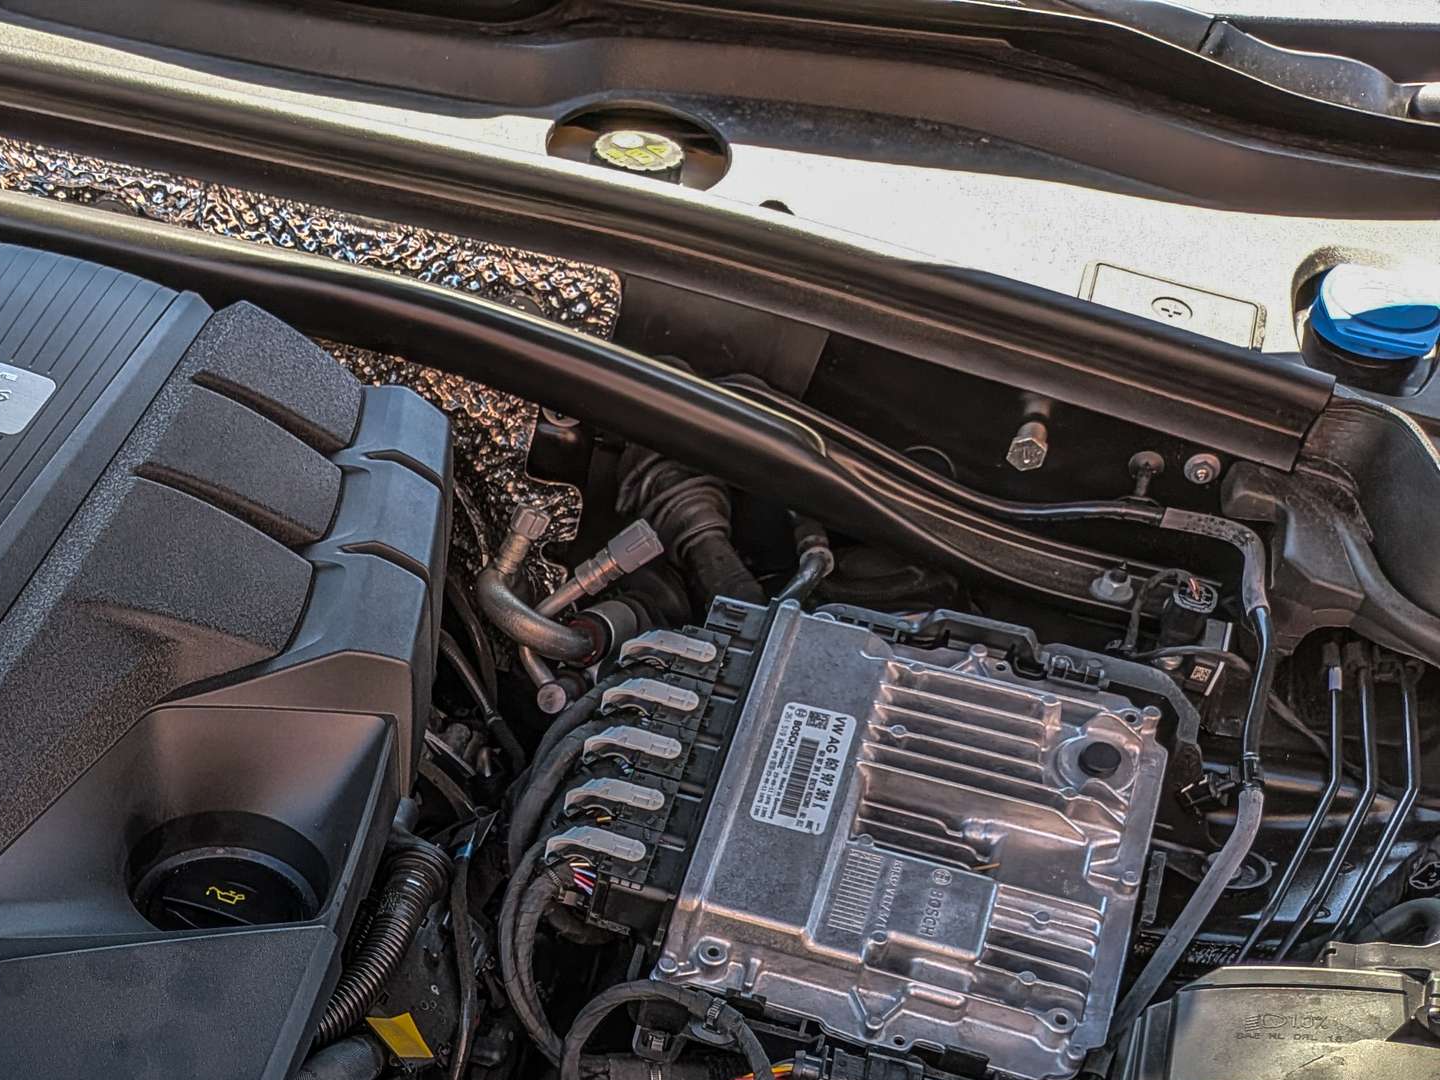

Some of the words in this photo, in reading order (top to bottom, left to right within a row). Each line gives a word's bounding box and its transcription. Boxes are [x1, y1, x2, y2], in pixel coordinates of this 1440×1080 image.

[787, 720, 802, 747] BOSCH
[832, 716, 848, 736] VW
[826, 737, 838, 753] AG
[919, 888, 945, 937] BOSCH
